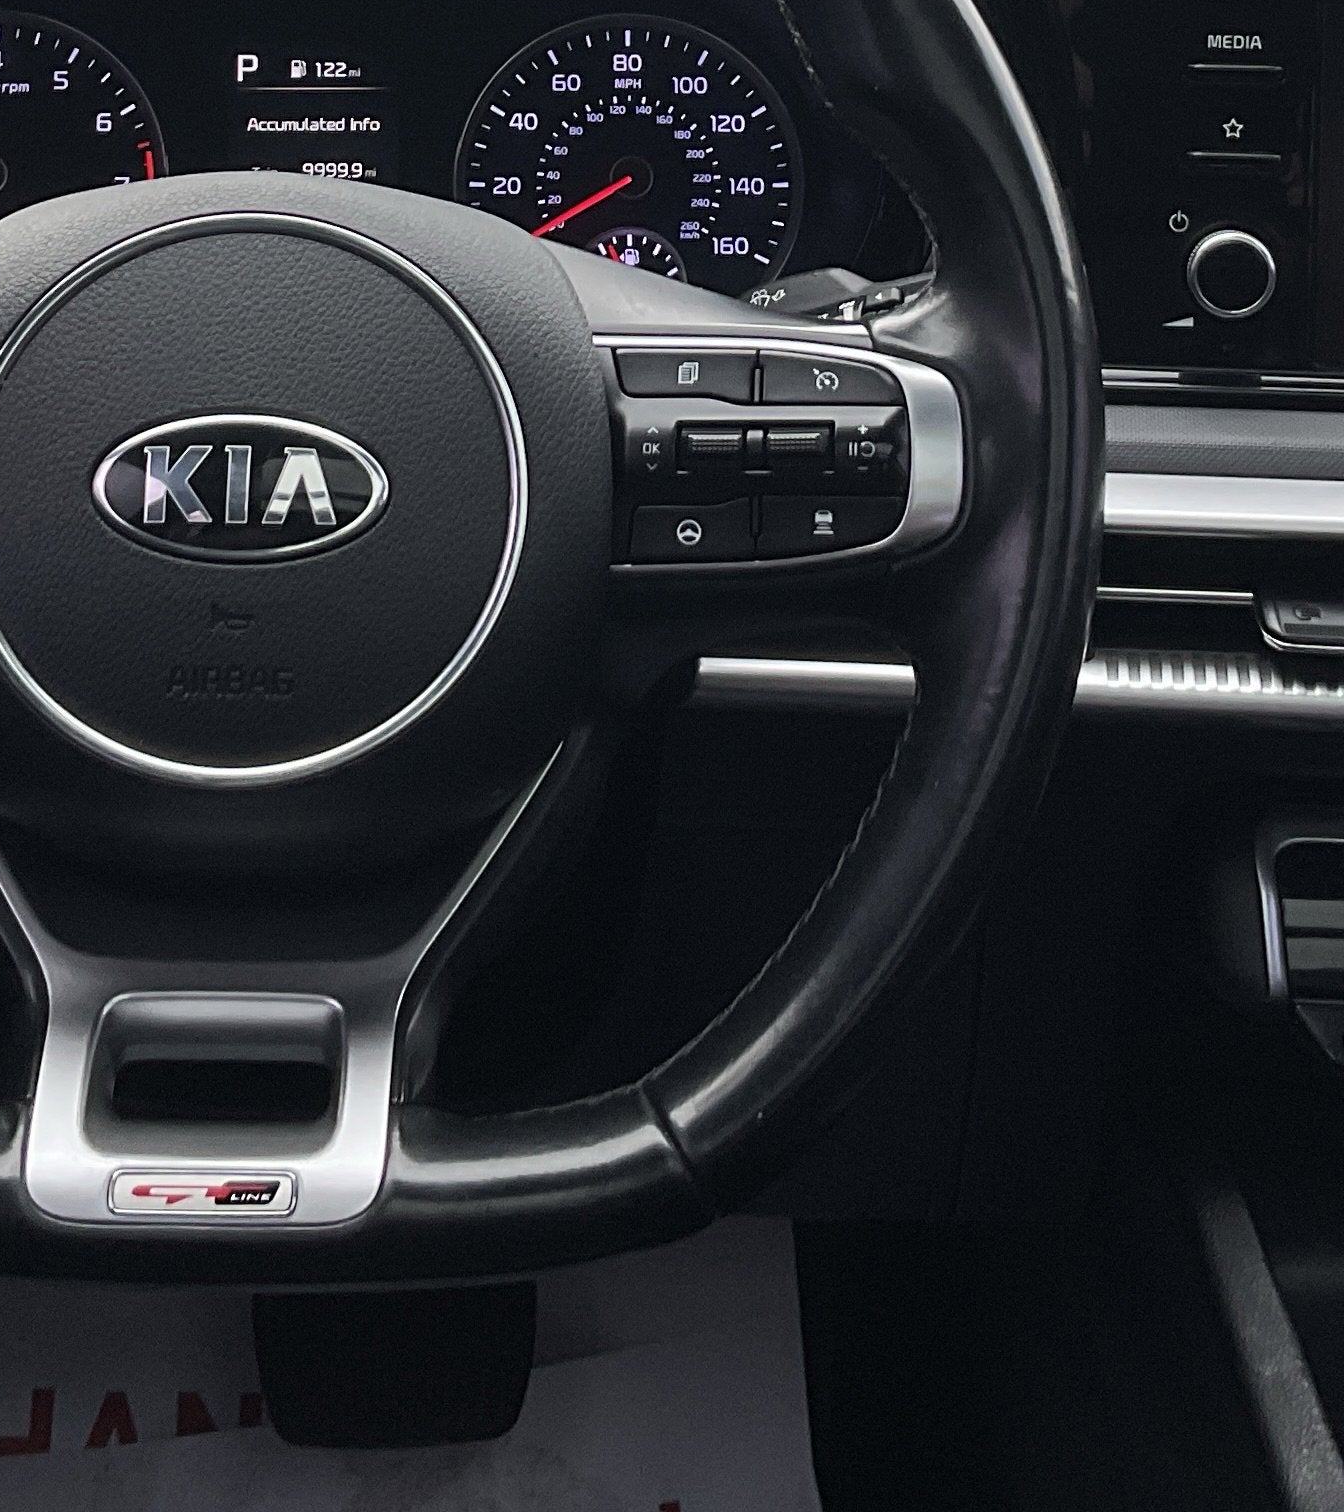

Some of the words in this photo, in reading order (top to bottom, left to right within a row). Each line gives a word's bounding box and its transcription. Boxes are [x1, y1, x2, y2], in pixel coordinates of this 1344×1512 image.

[1207, 35, 1262, 50] MEDIA
[237, 54, 258, 82] P
[613, 54, 642, 71] 80
[54, 71, 68, 89] 5
[552, 74, 581, 91] 60
[614, 79, 642, 88] MPH
[672, 77, 707, 94] 100
[96, 113, 112, 132] 6
[247, 118, 345, 132] Accumulated
[350, 118, 380, 131] Info
[509, 113, 538, 130] 40
[710, 115, 745, 132] 120
[686, 150, 704, 159] 200
[493, 177, 521, 194] 20
[693, 174, 711, 183] 220
[729, 178, 764, 195] 140
[691, 198, 709, 208] 240
[713, 237, 749, 255] 160
[643, 442, 660, 455] OK
[144, 445, 337, 525] KIA
[230, 1192, 272, 1202] LINE
